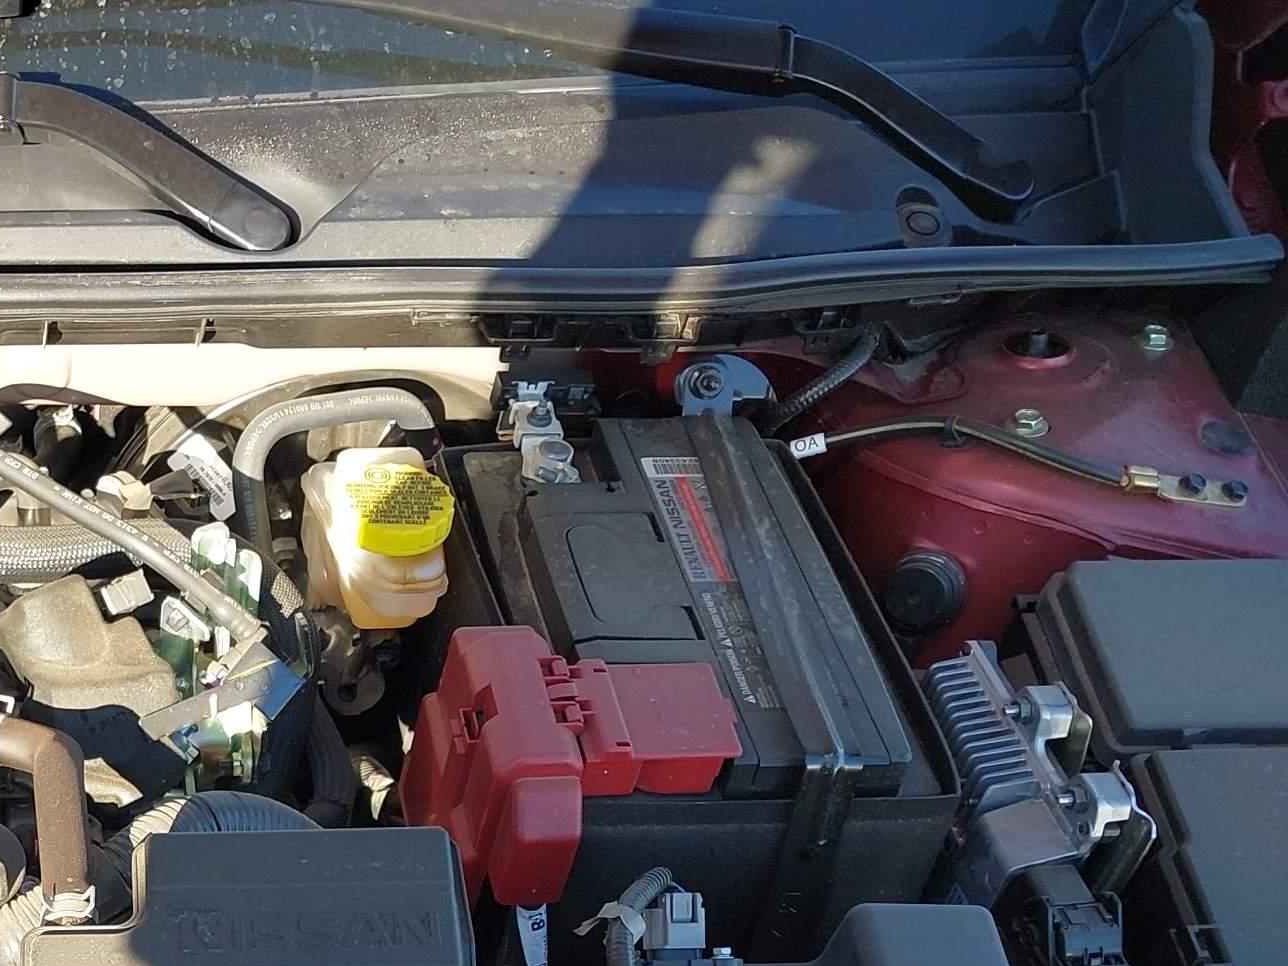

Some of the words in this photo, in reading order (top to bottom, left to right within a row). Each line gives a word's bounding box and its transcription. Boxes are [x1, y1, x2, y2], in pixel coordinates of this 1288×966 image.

[656, 479, 685, 529] NISSAN
[676, 532, 706, 580] RENAULT
[177, 910, 444, 949] NISSAN
